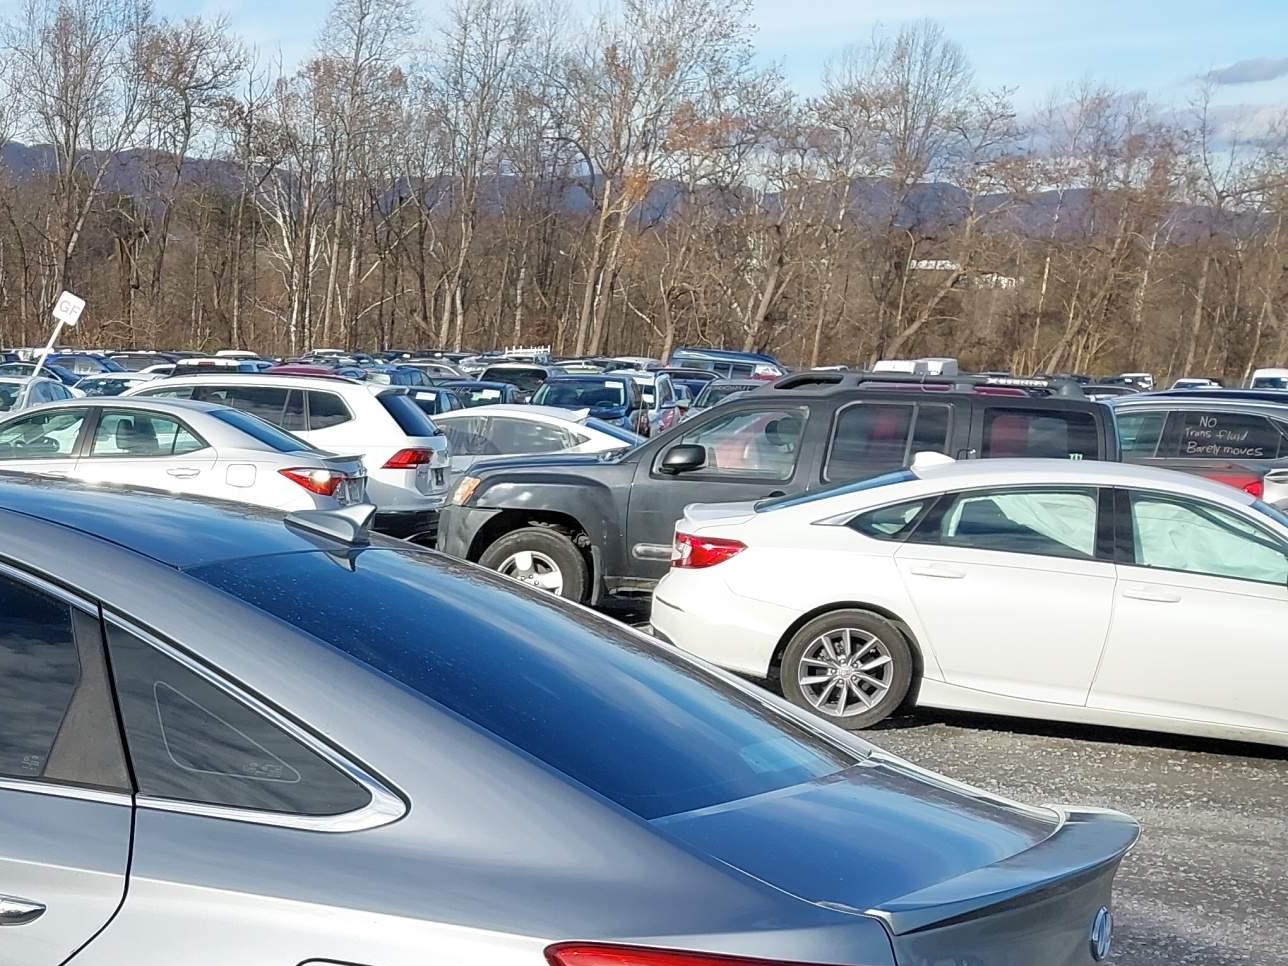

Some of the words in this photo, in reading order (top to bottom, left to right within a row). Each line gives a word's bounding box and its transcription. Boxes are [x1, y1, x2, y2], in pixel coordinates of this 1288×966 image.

[1199, 415, 1218, 428] NO
[1184, 427, 1213, 439] Trans
[1186, 440, 1222, 456] Barely
[1223, 446, 1264, 457] moves
